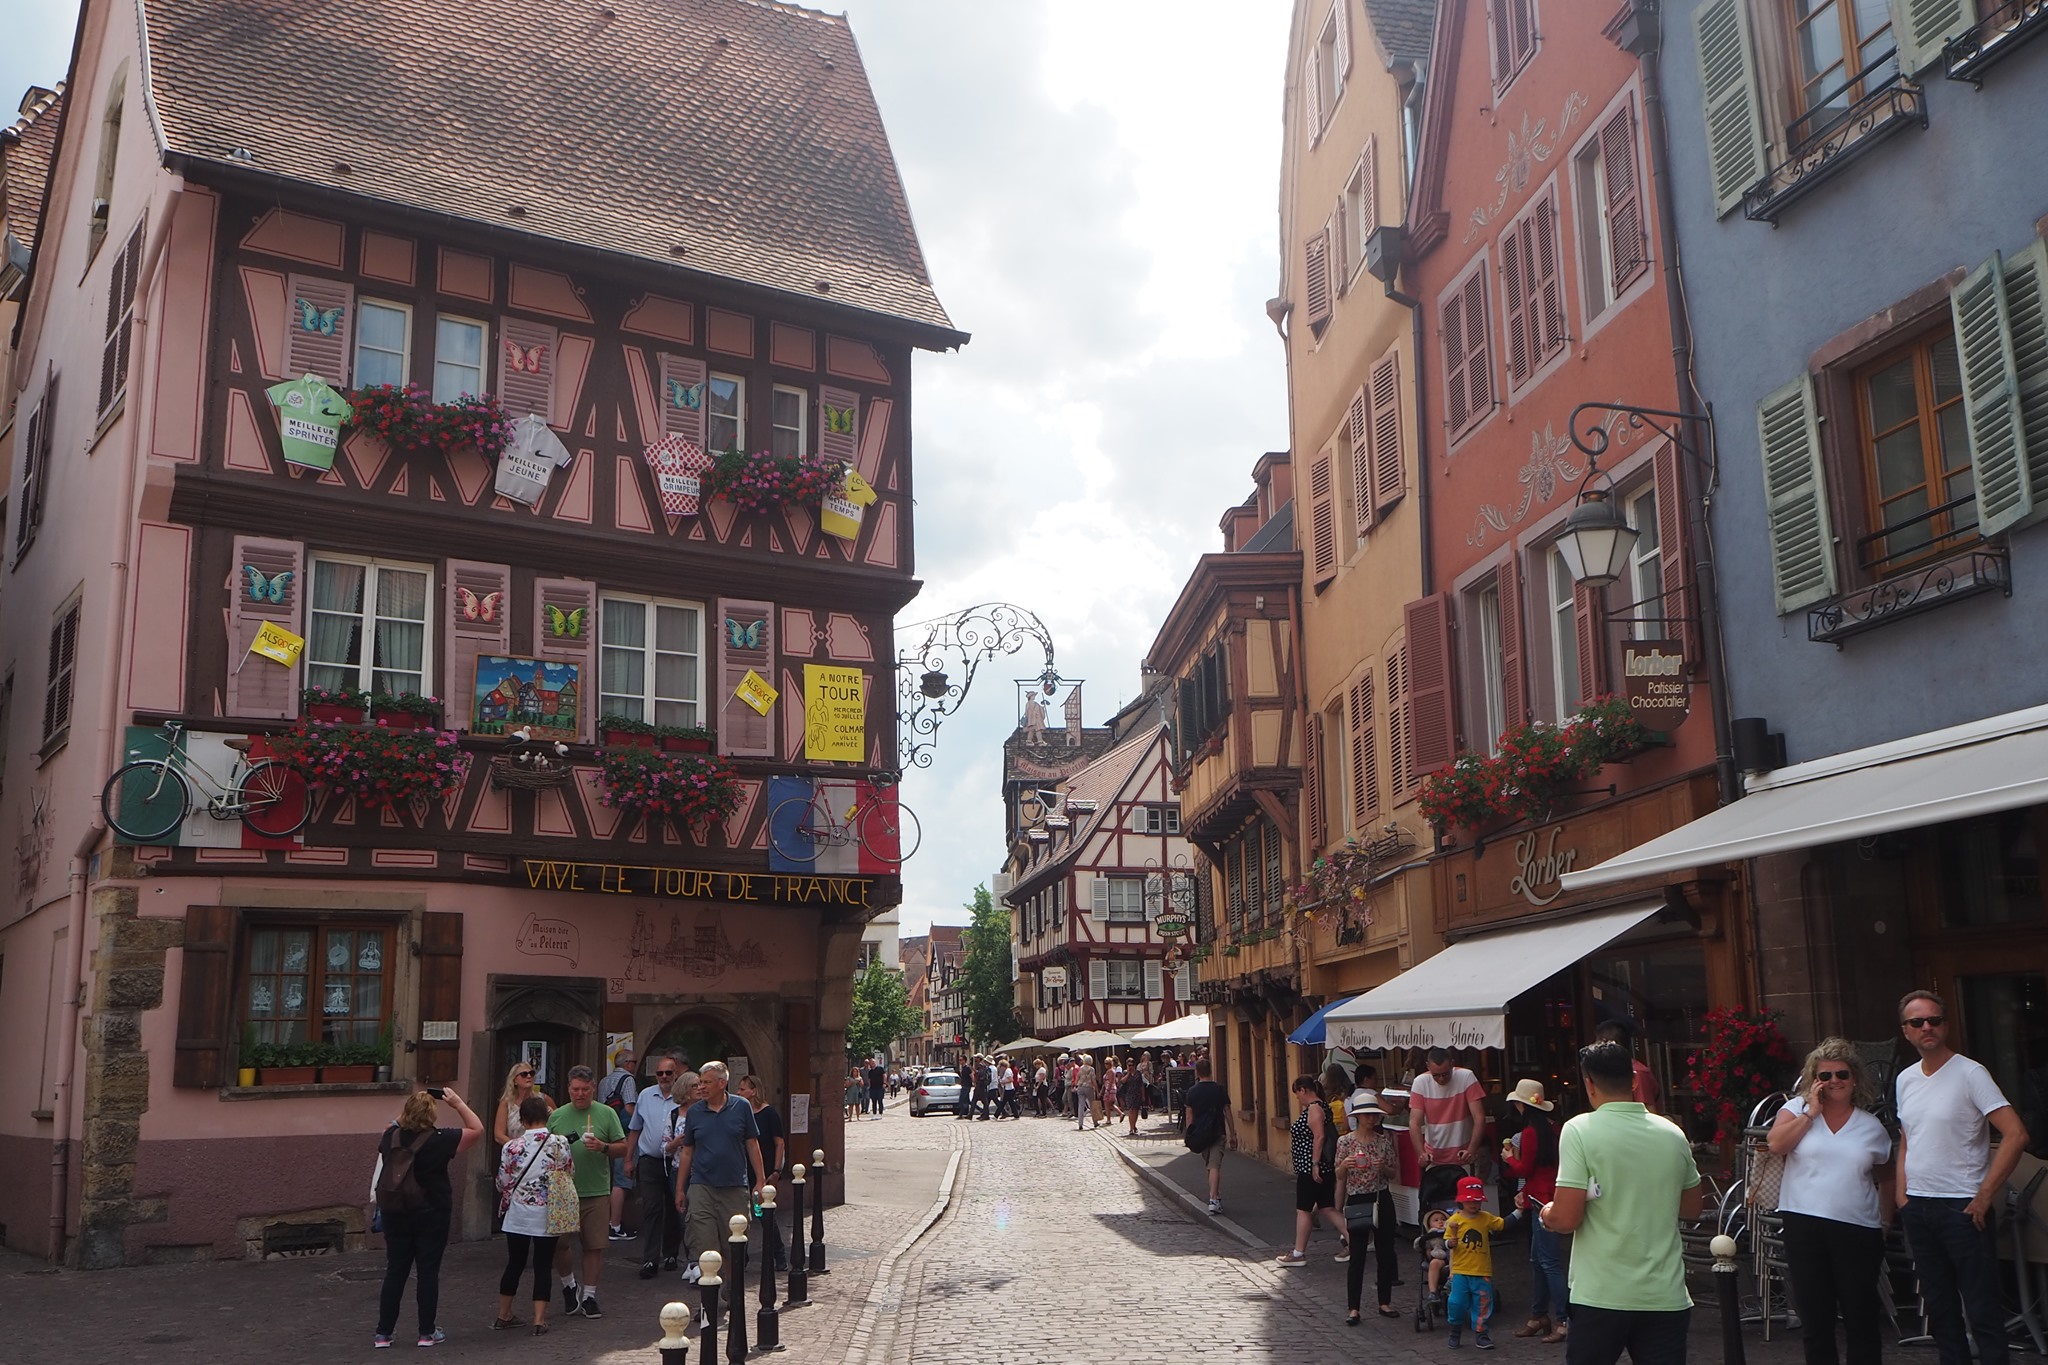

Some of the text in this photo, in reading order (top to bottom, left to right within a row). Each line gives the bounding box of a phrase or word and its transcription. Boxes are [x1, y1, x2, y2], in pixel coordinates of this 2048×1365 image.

[289, 419, 335, 436] MEILLEUR
[288, 428, 337, 447] SPRINTER
[507, 454, 547, 474] MEILLEUR
[509, 465, 541, 481] JEUNE
[663, 483, 701, 495] GRIMPEUR
[665, 477, 698, 488] MEILLEUR
[851, 477, 865, 487] LCL
[828, 495, 861, 511] MEILLEUR
[829, 502, 855, 517] TEMPS
[1625, 649, 1682, 677] Lorber
[820, 673, 860, 685] A NOTRE
[819, 685, 860, 702] TOUR
[1631, 695, 1686, 709] Chocolatier
[834, 725, 864, 734] COLMAR
[1510, 826, 1577, 906] Lorber
[524, 860, 874, 909] VIVE LE TOUR DE FRANCE
[532, 923, 557, 934] Maison
[1384, 1024, 1434, 1046] Chocolatier
[1449, 1021, 1485, 1045] Glacier
